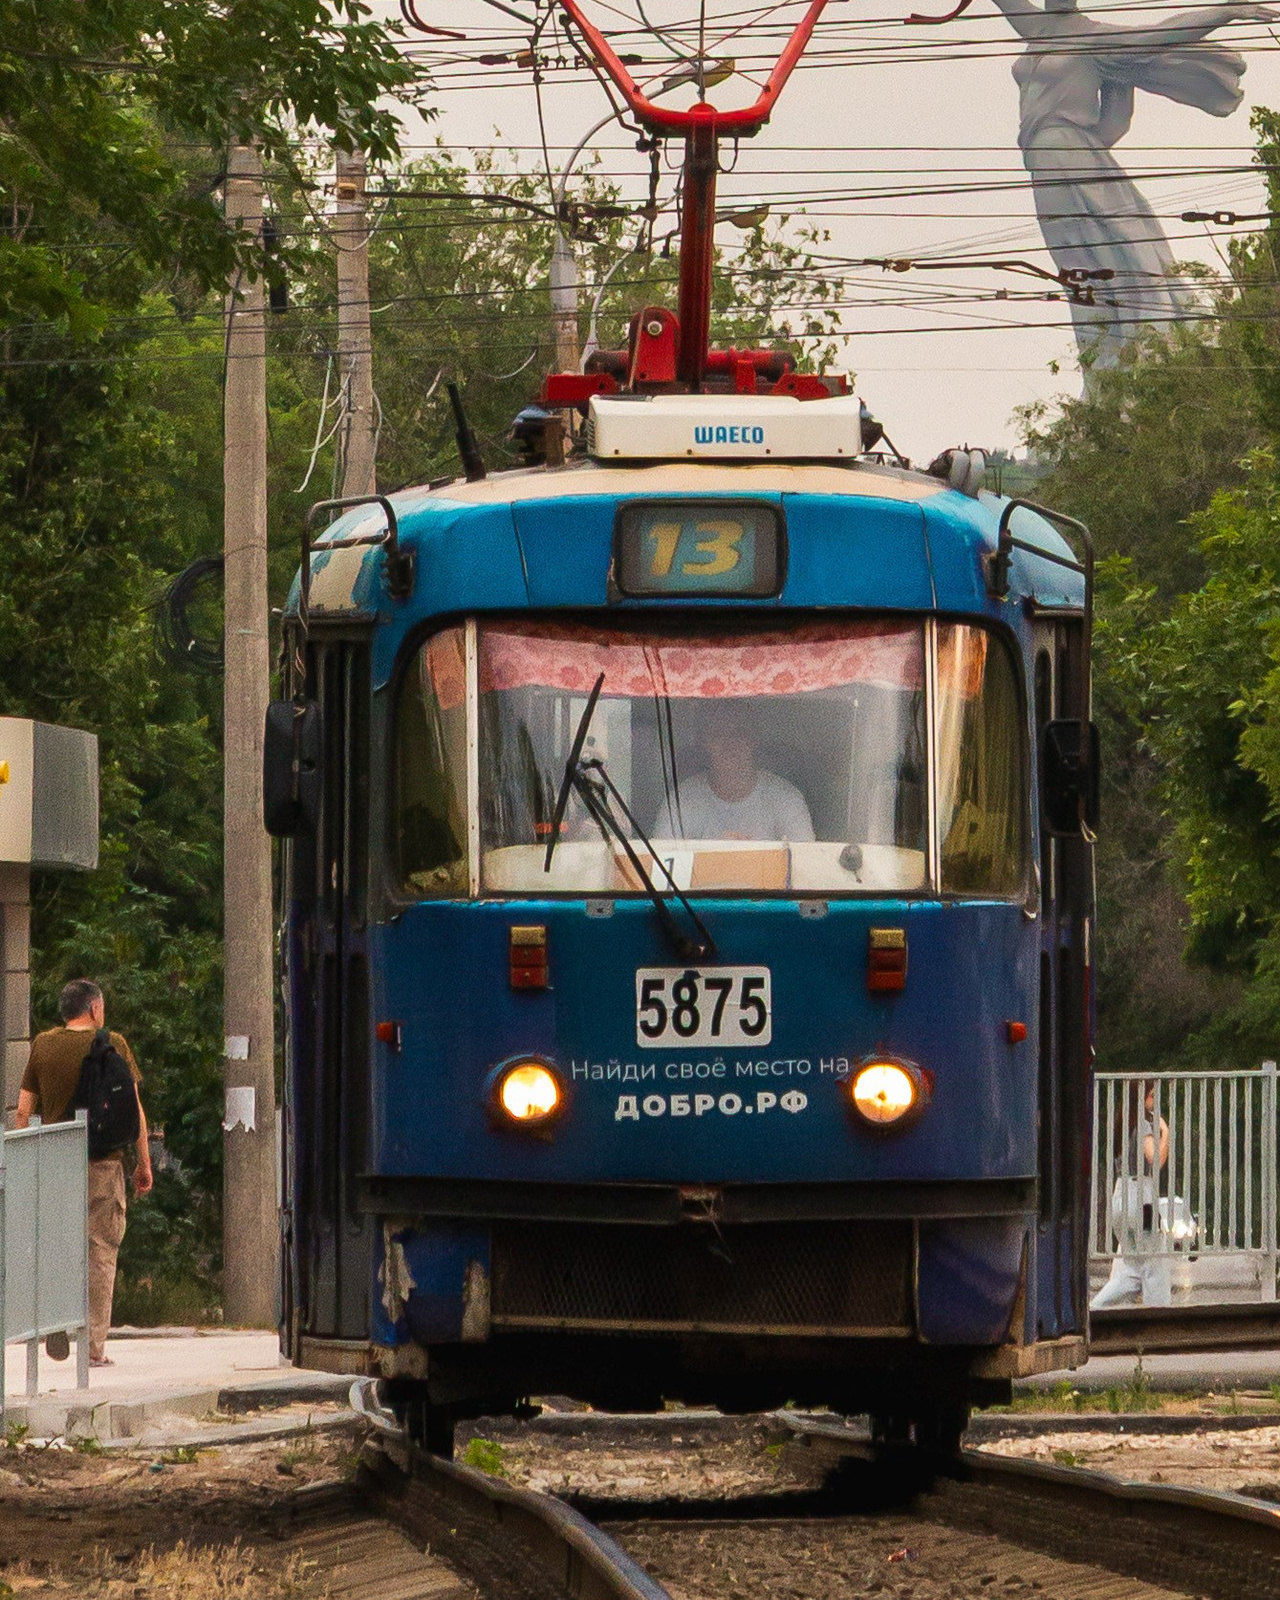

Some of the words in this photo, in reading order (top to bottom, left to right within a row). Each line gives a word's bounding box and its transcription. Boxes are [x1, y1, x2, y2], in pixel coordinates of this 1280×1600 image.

[694, 426, 764, 444] WAECO
[649, 521, 743, 577] 13
[639, 977, 767, 1038] 5875
[571, 1058, 656, 1083] Найди
[665, 1056, 727, 1079] своё
[736, 1059, 811, 1076] место
[820, 1055, 849, 1074] на
[614, 1089, 808, 1121] ДОБРО.РФ
